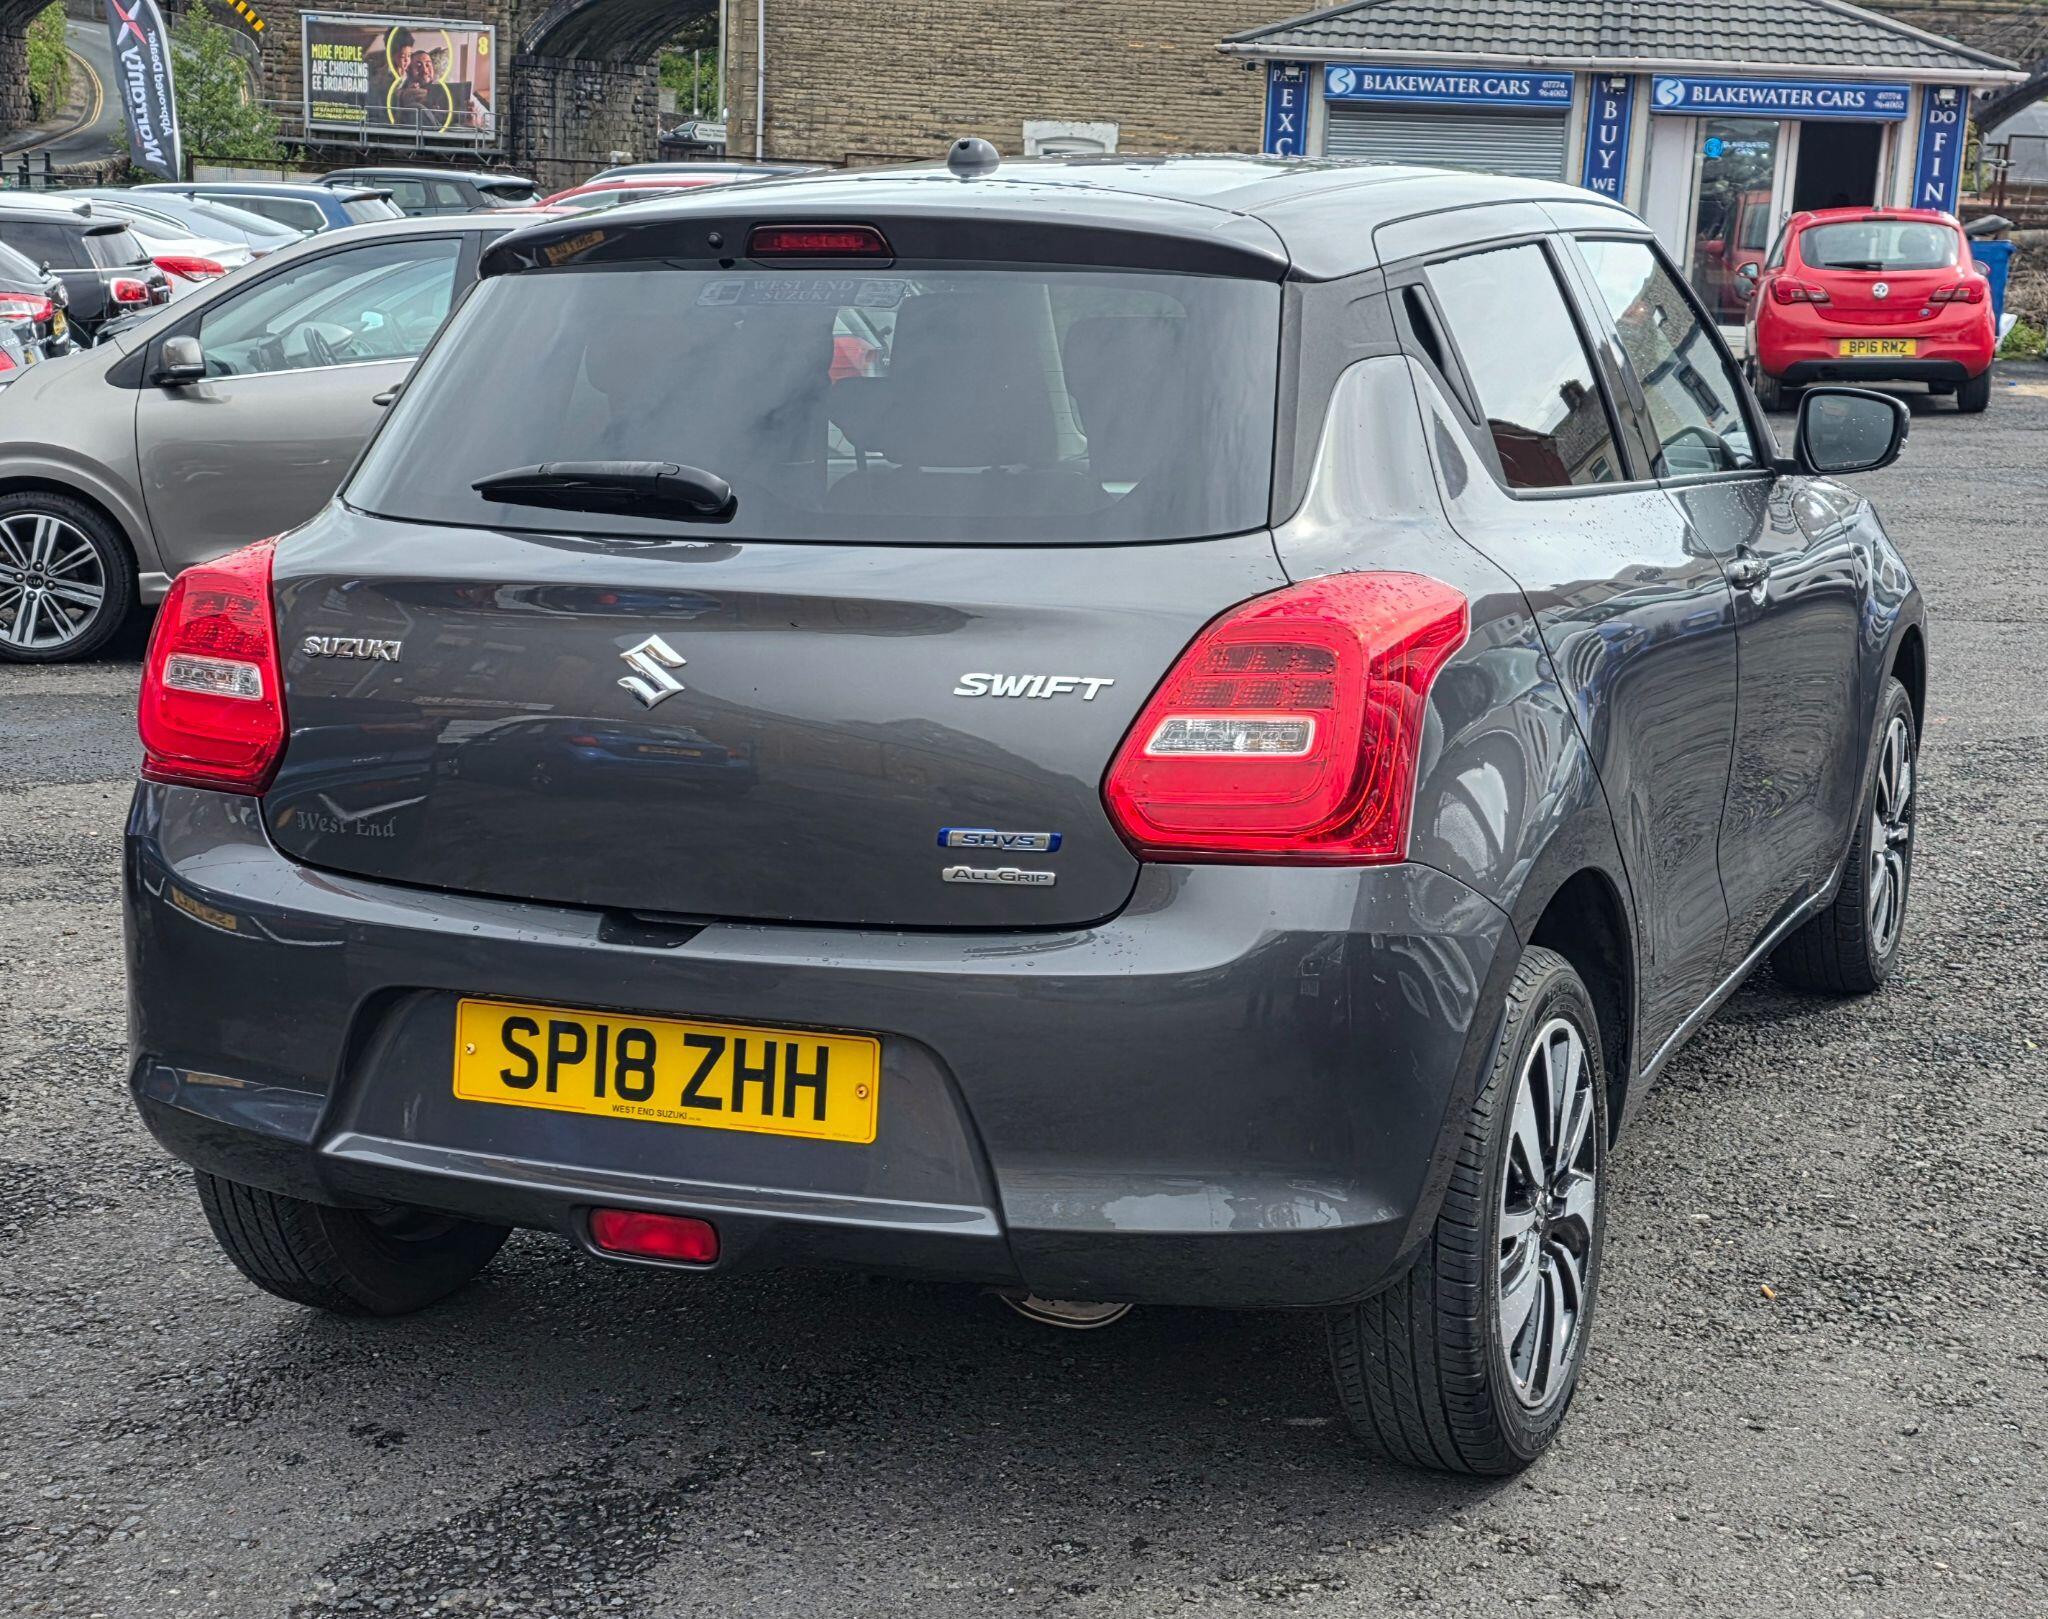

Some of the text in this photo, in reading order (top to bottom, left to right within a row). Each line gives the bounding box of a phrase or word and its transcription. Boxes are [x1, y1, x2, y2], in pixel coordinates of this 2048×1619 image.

[312, 44, 363, 61] MORE PEOPLE
[312, 60, 369, 77] ARE CHOOSING
[1273, 69, 1306, 82] PAT
[312, 75, 368, 93] EE BROADBAND
[1363, 75, 1531, 95] BLAKEWATER CARS
[1691, 86, 1867, 107] BLAKEWATER CARS
[1929, 110, 1957, 123] DO
[1598, 100, 1618, 168] BUY
[1924, 132, 1948, 210] FIN
[1592, 178, 1616, 191] WE
[811, 279, 854, 291] END
[1849, 341, 1907, 353] BP16 RMZ
[302, 635, 402, 663] SUZUKI
[953, 672, 1115, 701] SWIFT
[355, 815, 397, 837] End
[961, 833, 1035, 847] SHVS
[500, 1016, 830, 1121] SP18 ZHH
[612, 1104, 636, 1114] WEST
[637, 1107, 655, 1117] END
[656, 1109, 688, 1120] SUZUKI
